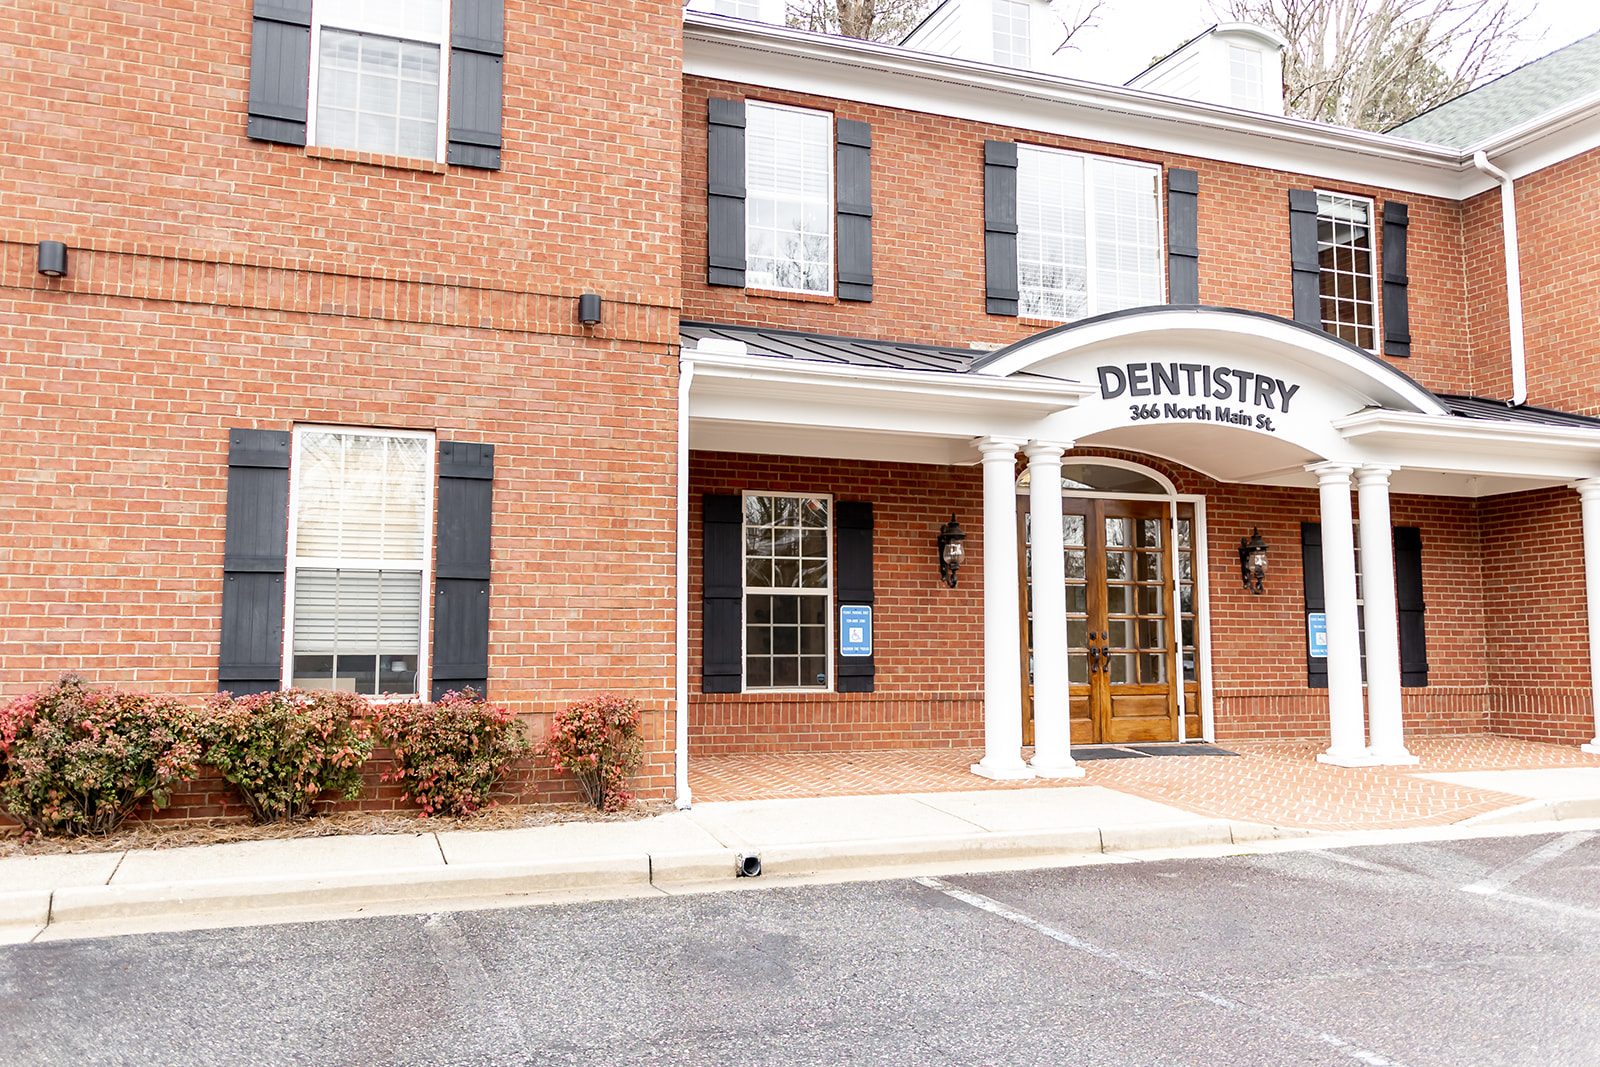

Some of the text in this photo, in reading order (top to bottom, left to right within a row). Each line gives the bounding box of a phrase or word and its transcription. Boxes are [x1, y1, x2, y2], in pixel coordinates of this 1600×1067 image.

[1097, 362, 1300, 413] DENTISTRY
[1129, 403, 1276, 432] 366 North Main St.
